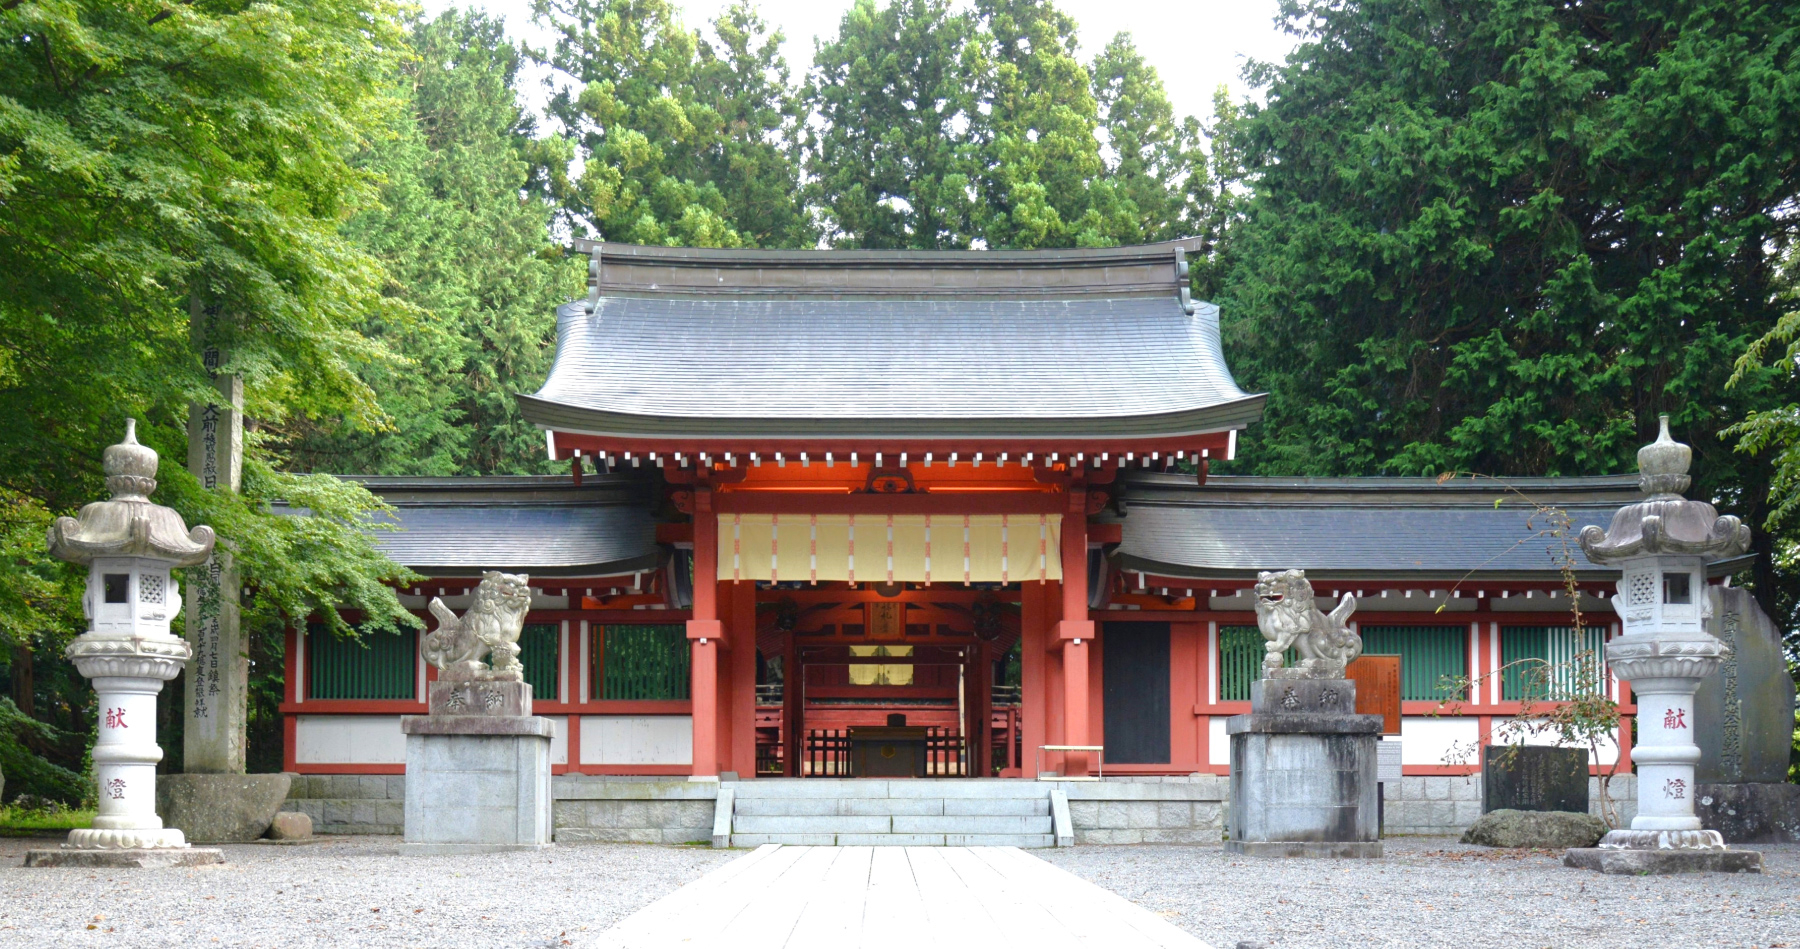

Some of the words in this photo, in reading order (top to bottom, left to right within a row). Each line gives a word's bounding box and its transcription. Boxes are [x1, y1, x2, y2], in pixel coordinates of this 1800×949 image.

[446, 688, 504, 710] 奉納
[1281, 687, 1338, 709] 奉納
[105, 707, 128, 800] 献燈
[1663, 707, 1687, 800] 献燈
